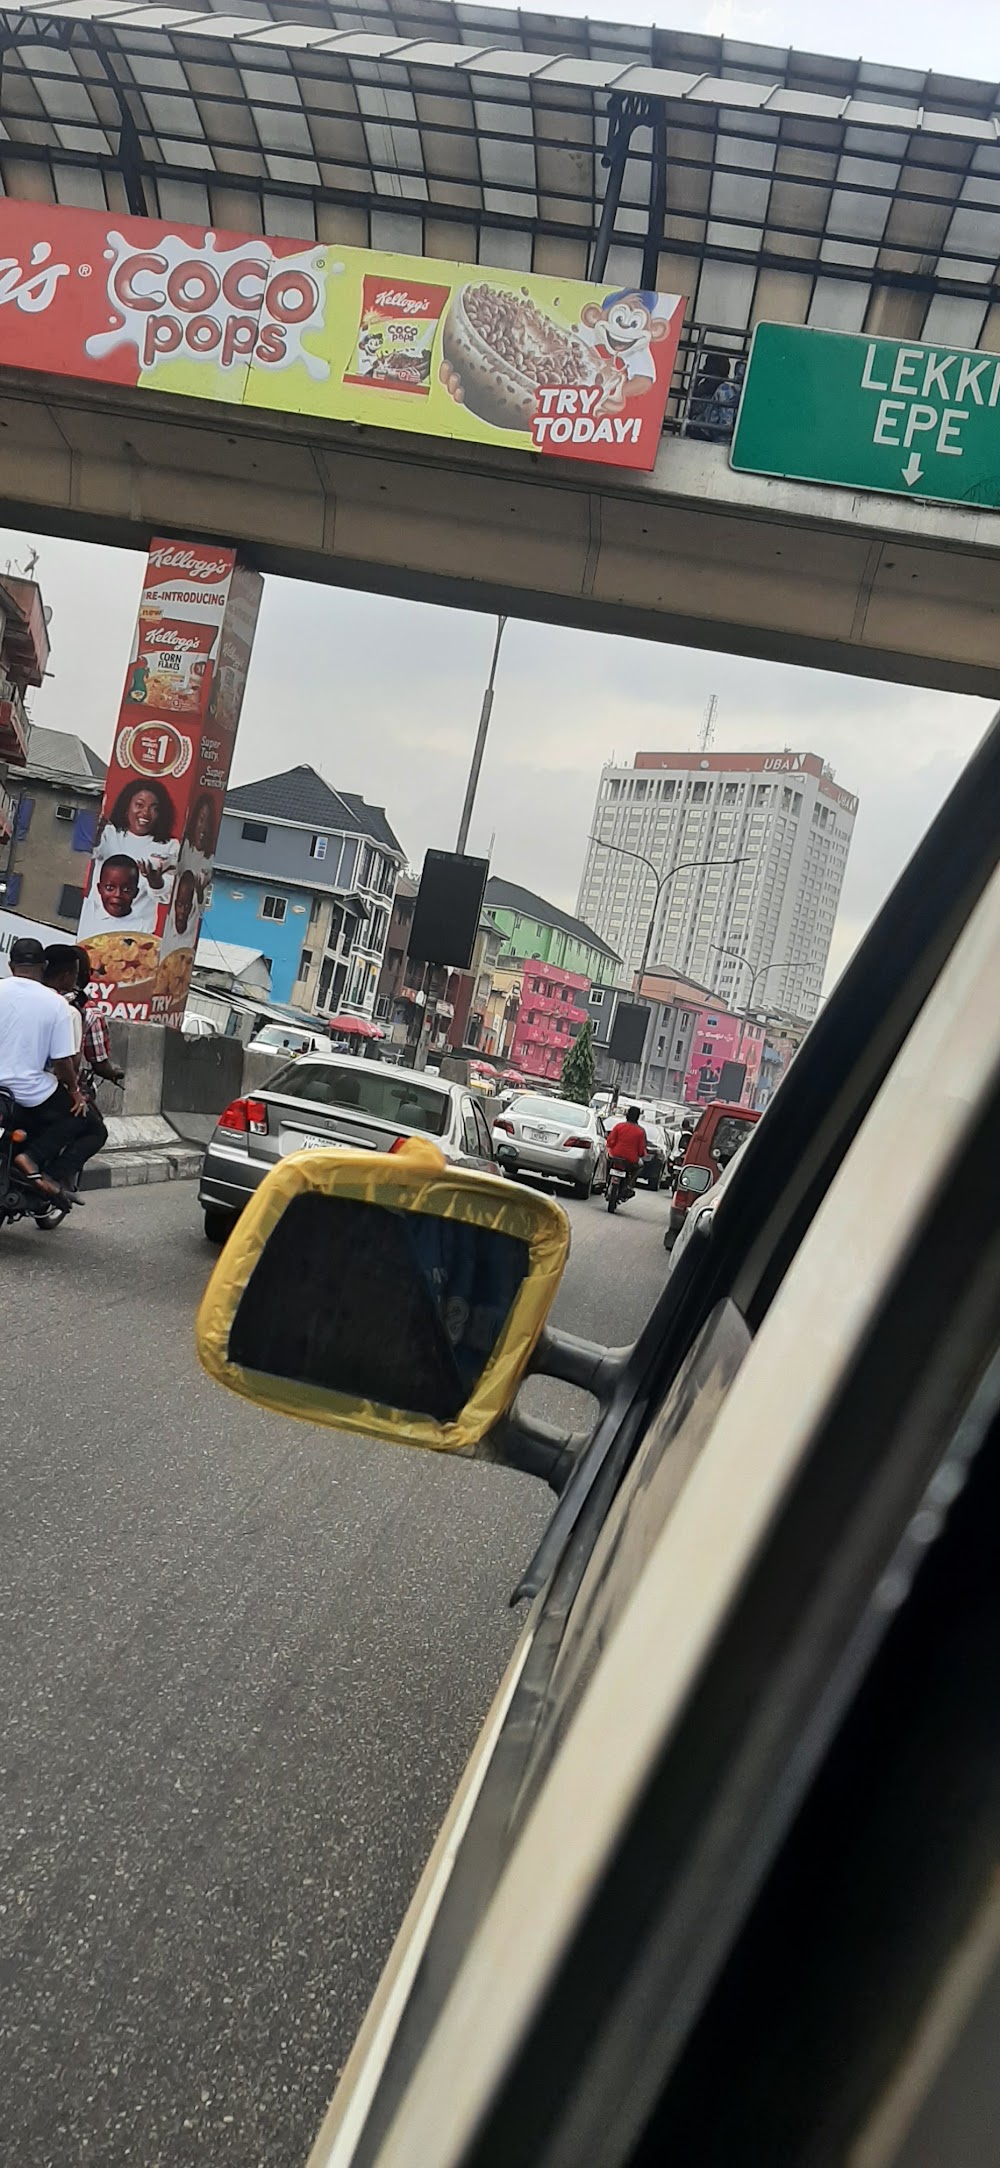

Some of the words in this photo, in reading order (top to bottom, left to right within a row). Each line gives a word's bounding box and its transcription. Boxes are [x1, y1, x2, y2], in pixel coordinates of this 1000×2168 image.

[375, 289, 430, 314] Kellogg's
[143, 314, 287, 366] pops
[861, 344, 1000, 407] LEKKI
[539, 388, 600, 414] TRY
[533, 417, 642, 443] TODAY!
[873, 399, 969, 456] EPE
[148, 546, 228, 579] Kellogg's
[145, 591, 225, 606] RE-INTRODUCING
[145, 628, 200, 652] Kellogg's
[158, 661, 180, 671] FLAKES
[159, 652, 182, 663] CORN
[201, 735, 221, 749] Super
[205, 765, 225, 780] Super
[764, 758, 790, 770] UBA
[83, 982, 115, 999] RY
[97, 1001, 149, 1020] DAY!
[152, 996, 172, 1012] TRY
